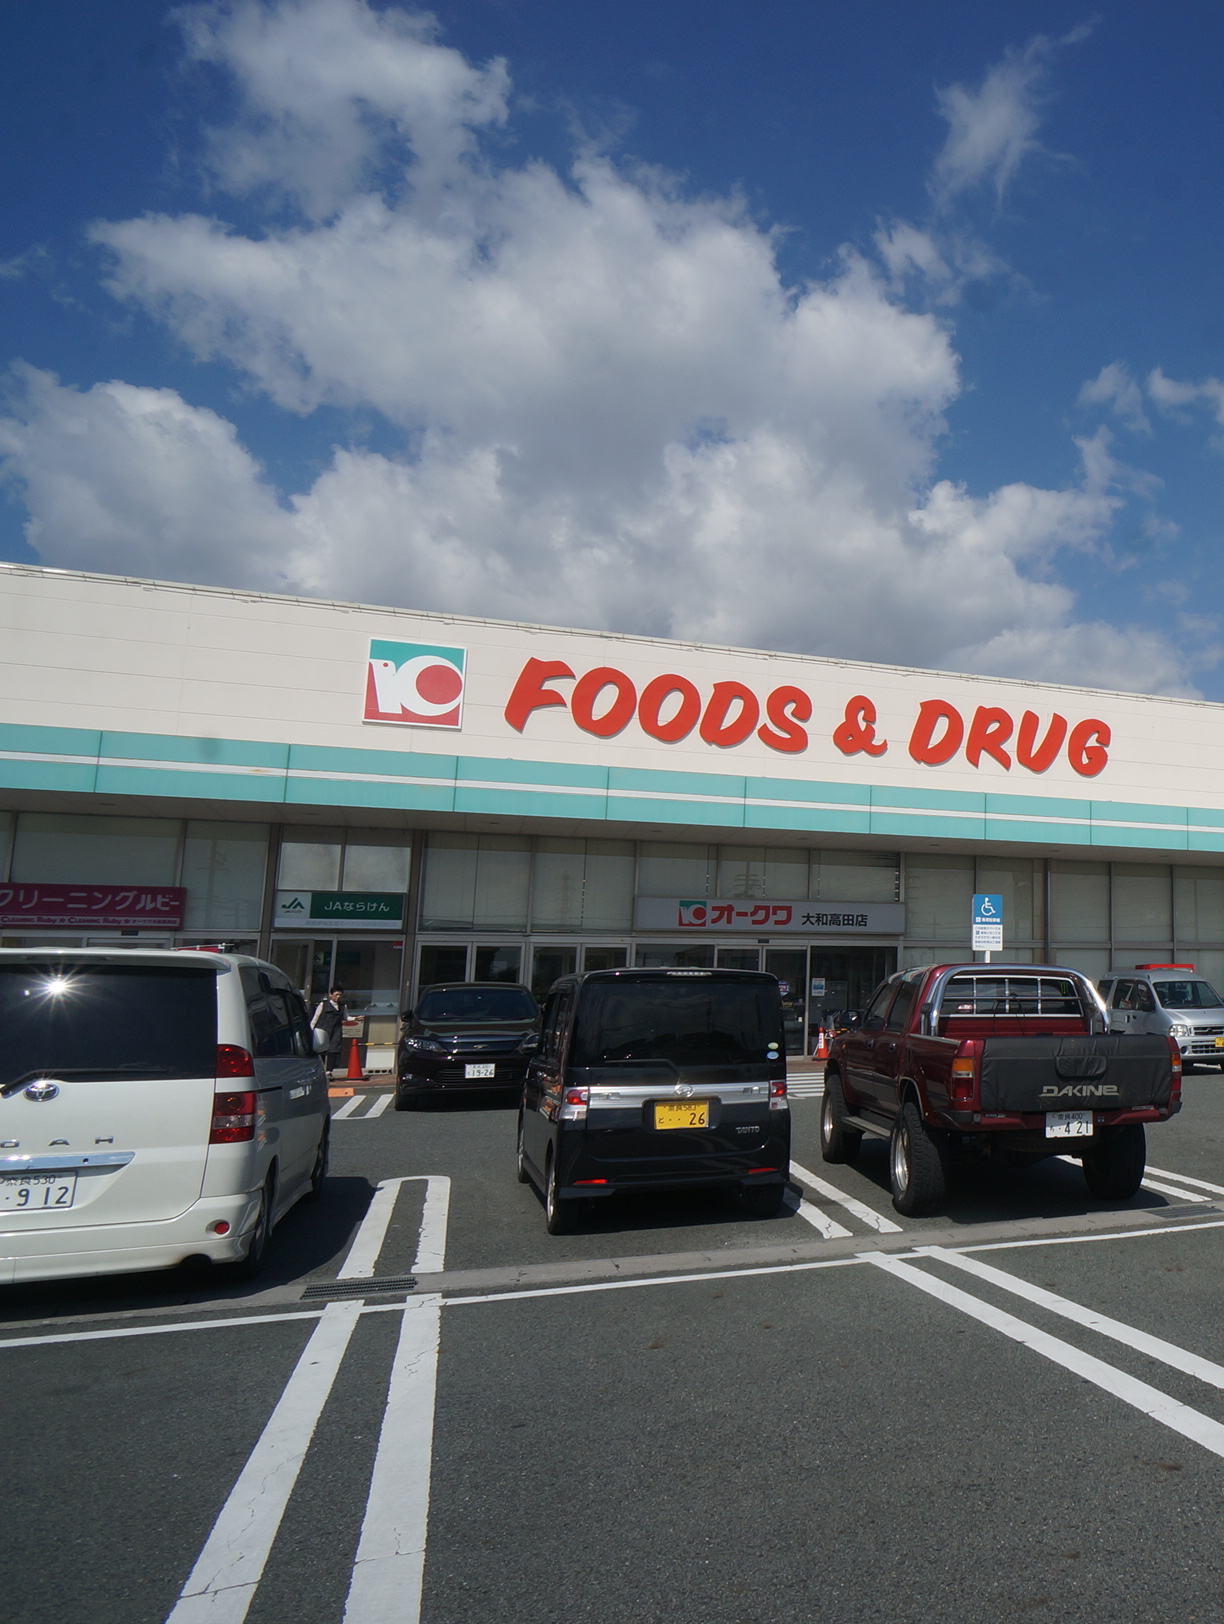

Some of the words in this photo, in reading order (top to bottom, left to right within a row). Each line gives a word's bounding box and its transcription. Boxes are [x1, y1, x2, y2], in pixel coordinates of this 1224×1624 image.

[504, 657, 812, 753] FOODS
[832, 695, 888, 758] &
[908, 699, 1112, 778] DRUG
[324, 901, 390, 912] JAならけん
[710, 904, 793, 926] オークワ
[801, 913, 869, 927] 大和高田店
[1039, 1085, 1119, 1097] DAKINE
